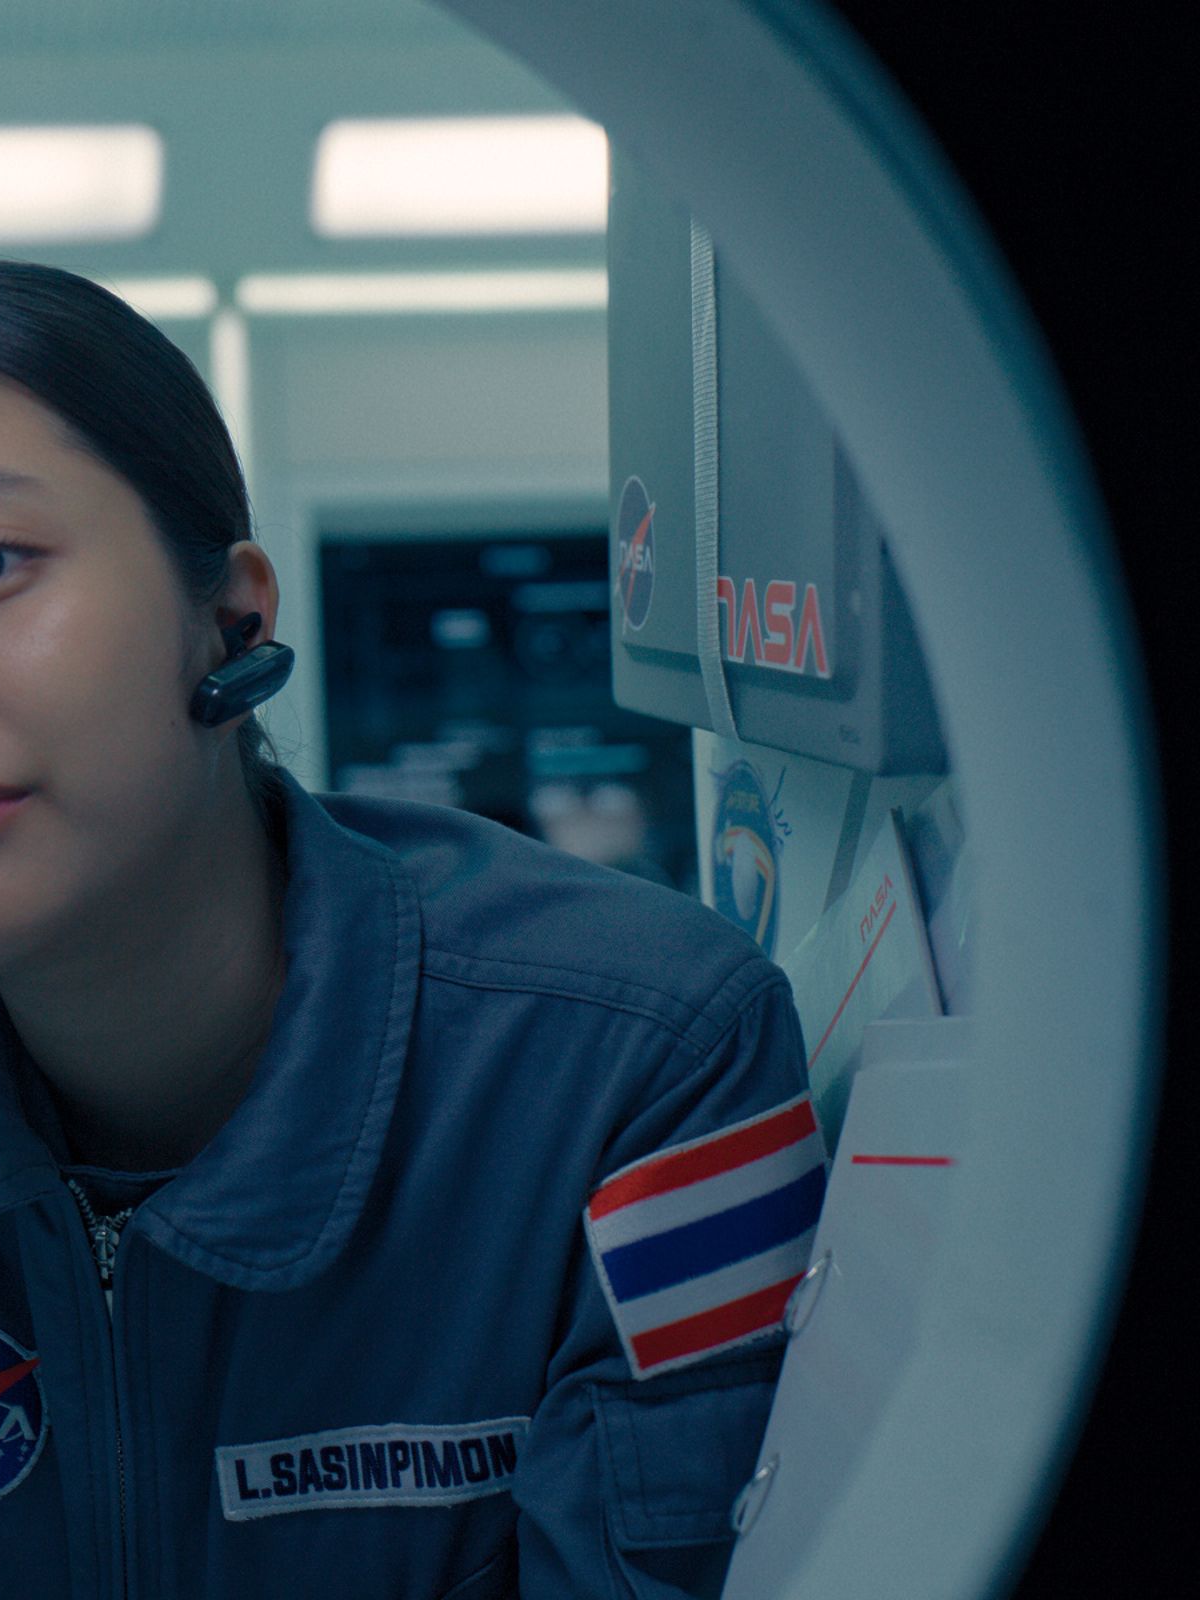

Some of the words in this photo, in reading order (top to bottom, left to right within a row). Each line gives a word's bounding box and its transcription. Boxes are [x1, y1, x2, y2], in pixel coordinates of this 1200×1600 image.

[619, 540, 651, 572] NASA
[858, 872, 893, 943] NASA
[234, 1432, 517, 1501] L.SASINPIMON
